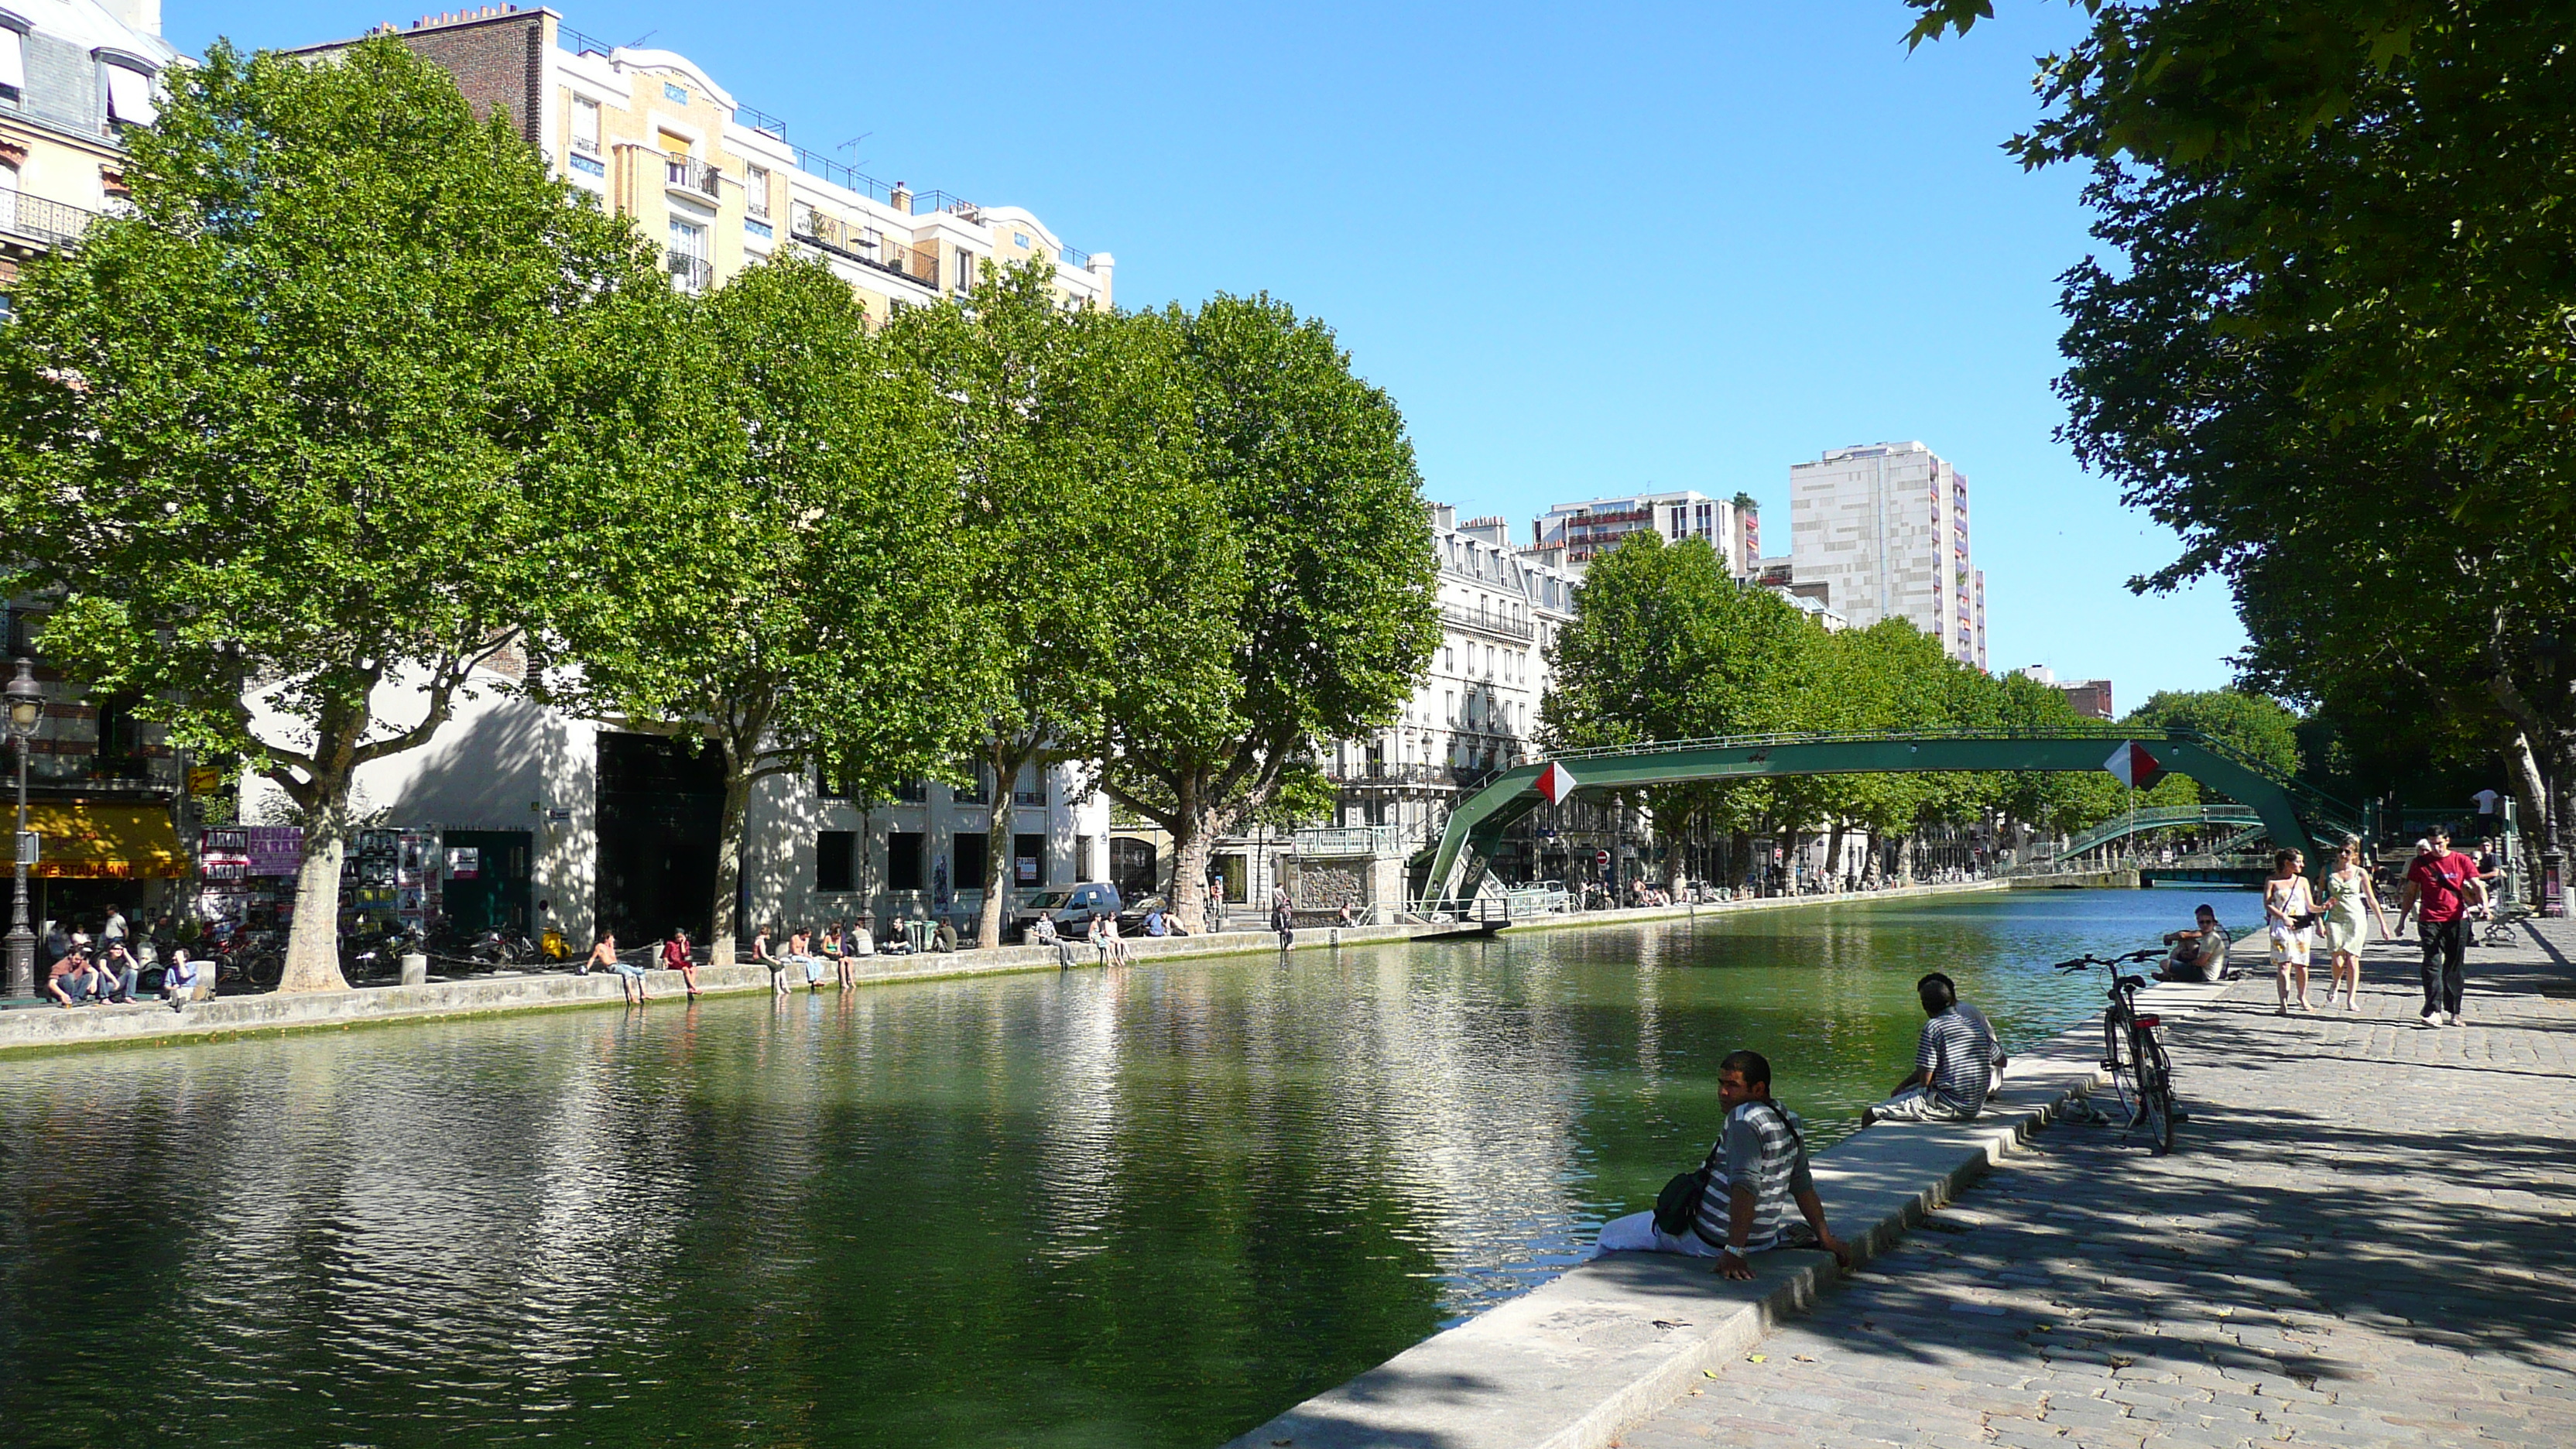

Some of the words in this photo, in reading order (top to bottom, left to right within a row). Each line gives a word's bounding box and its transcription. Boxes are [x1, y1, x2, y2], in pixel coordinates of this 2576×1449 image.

[206, 832, 245, 848] AKON
[250, 827, 301, 840] KENZA
[250, 841, 303, 853] FARAH
[39, 864, 135, 877] RESTAURANT
[159, 867, 183, 877] BAR
[206, 864, 245, 879] AKON
